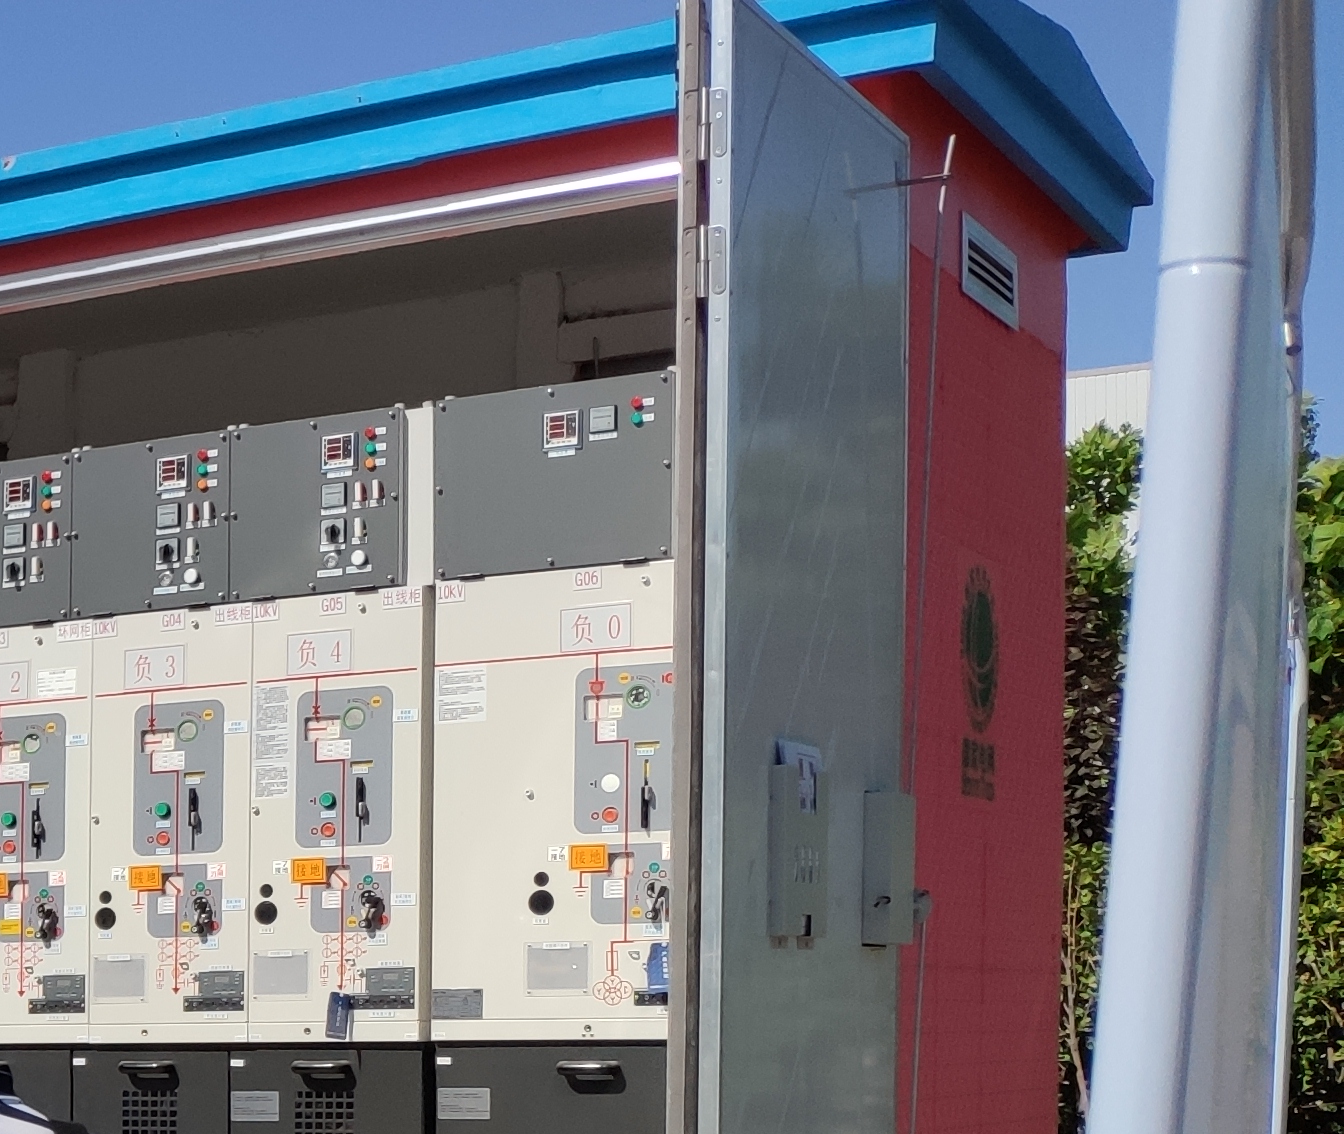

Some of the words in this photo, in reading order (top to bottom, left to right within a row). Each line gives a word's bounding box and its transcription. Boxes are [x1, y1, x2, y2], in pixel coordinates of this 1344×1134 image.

[575, 571, 598, 587] G06
[383, 589, 420, 606] 出线柜
[438, 584, 463, 600] 10kV
[254, 603, 278, 618] 10kV
[322, 597, 343, 612] G05
[162, 613, 182, 628] G04
[215, 606, 251, 623] 出线柜
[94, 620, 116, 635] 10kV
[572, 614, 593, 646] 负
[608, 614, 620, 640] 0
[297, 639, 317, 670] 负
[330, 640, 342, 664] 4
[134, 654, 152, 684] 负
[165, 655, 176, 678] 3
[11, 671, 21, 693] 2
[575, 849, 602, 865] 接地
[296, 862, 321, 878] 接地
